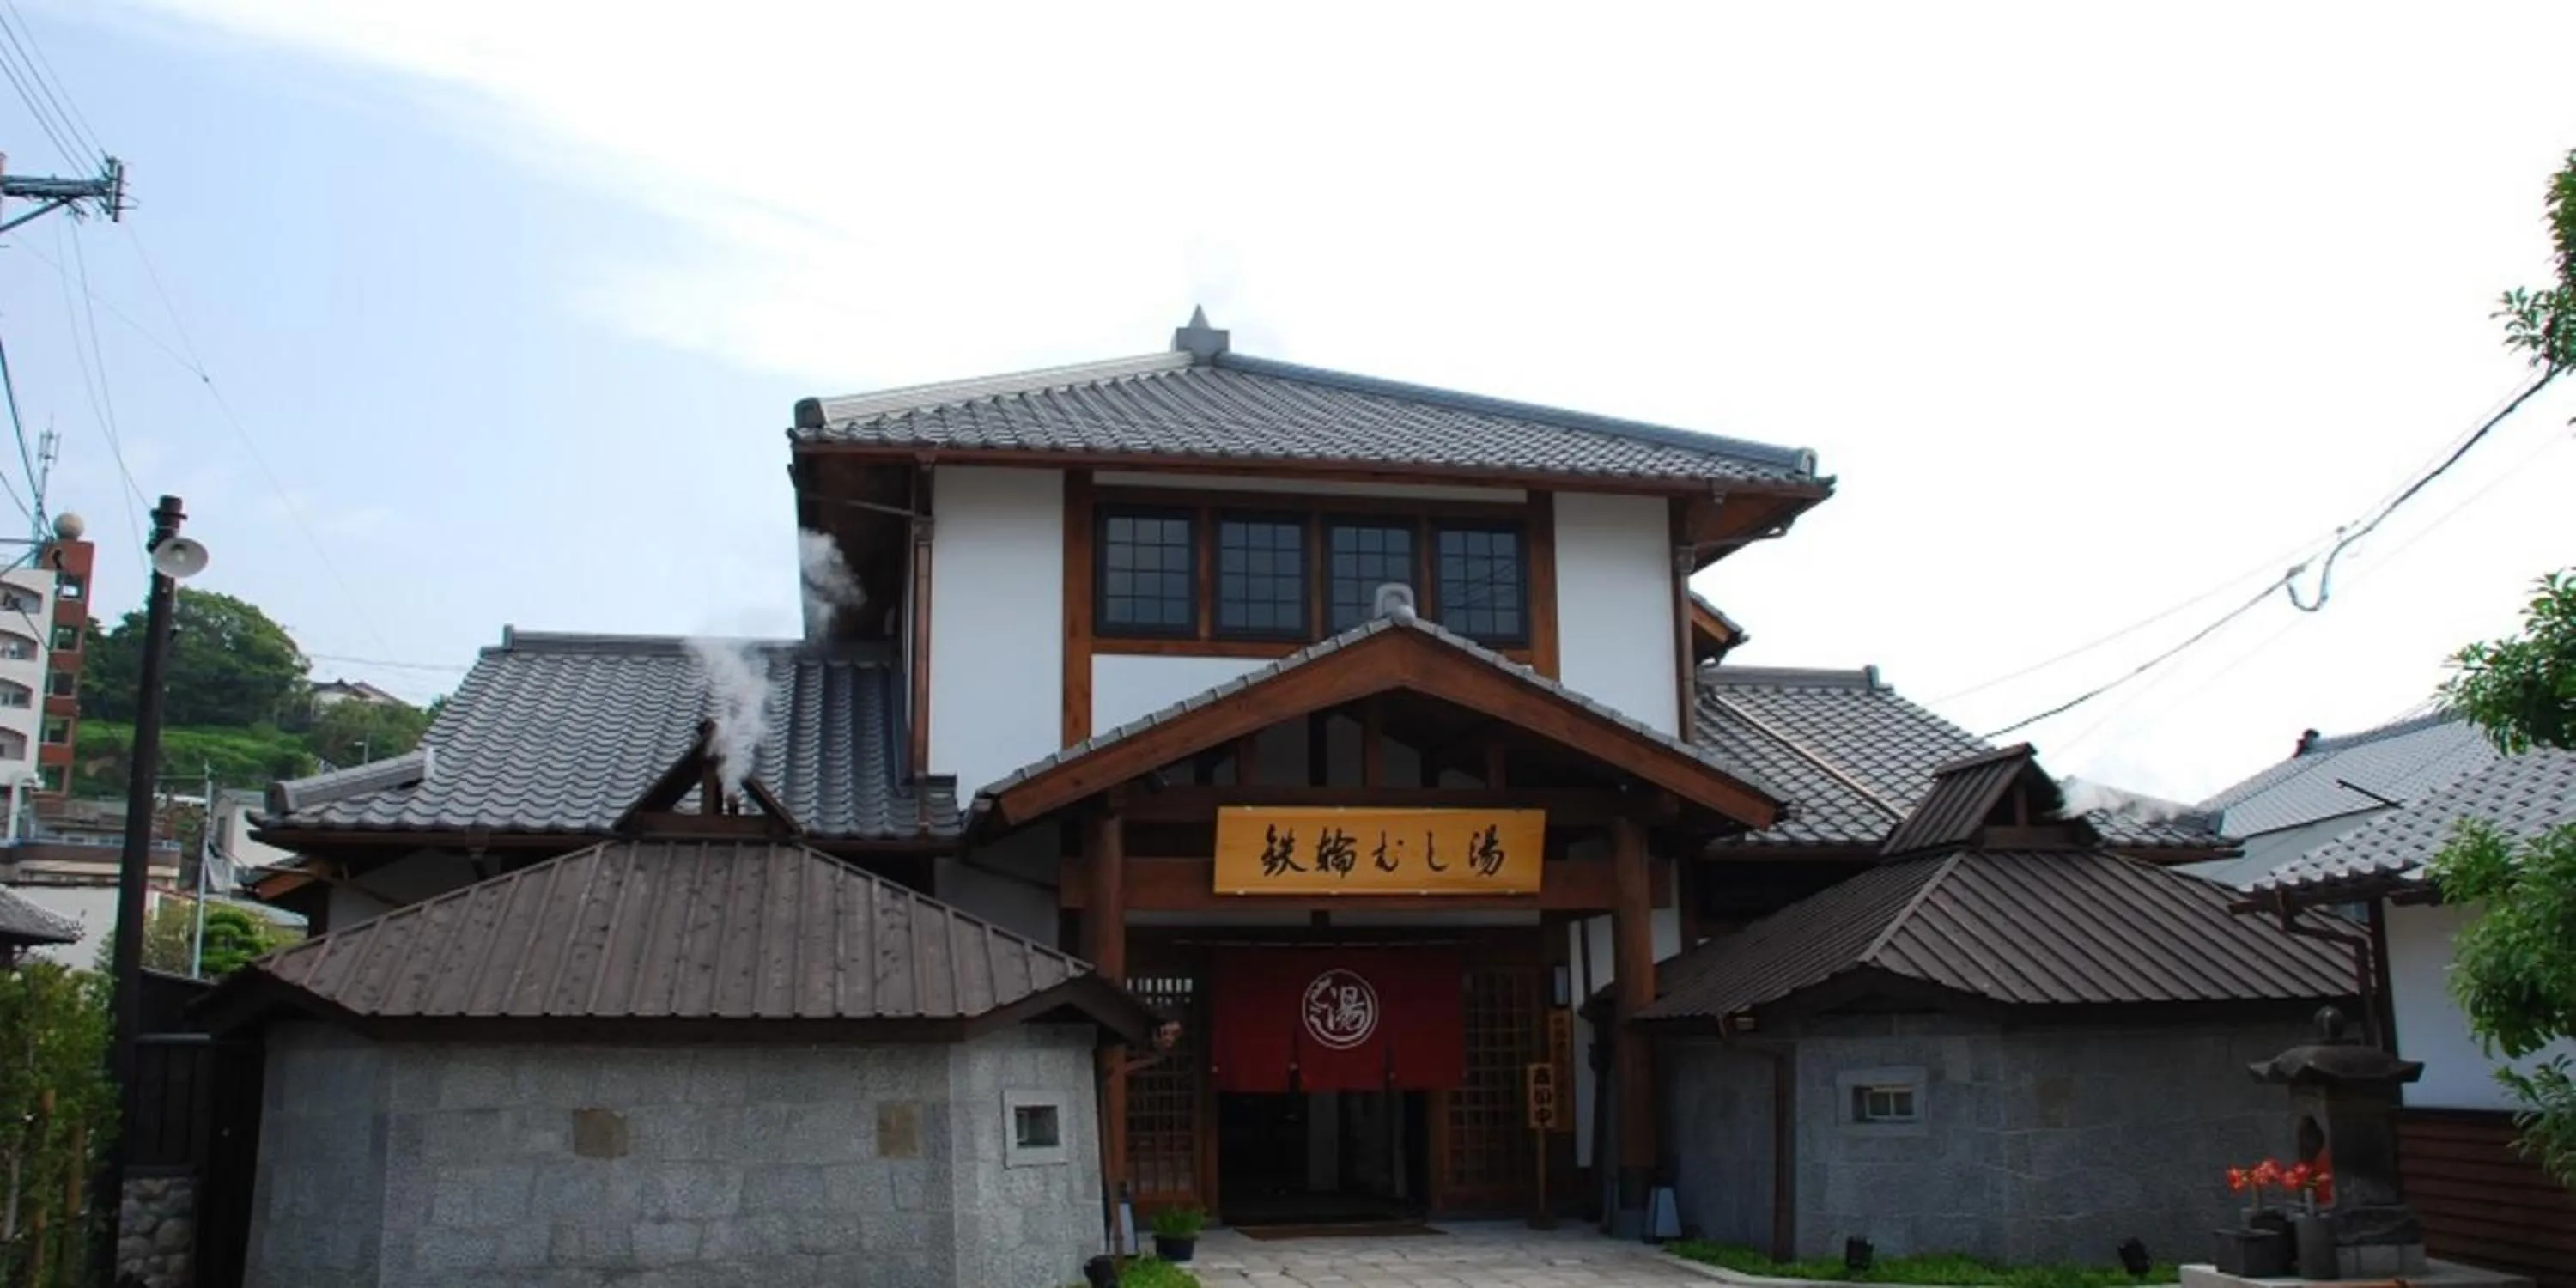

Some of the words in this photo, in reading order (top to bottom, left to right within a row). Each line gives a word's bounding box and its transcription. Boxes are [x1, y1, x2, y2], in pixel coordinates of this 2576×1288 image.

[1260, 823, 1505, 878] 鉄輪むし湯
